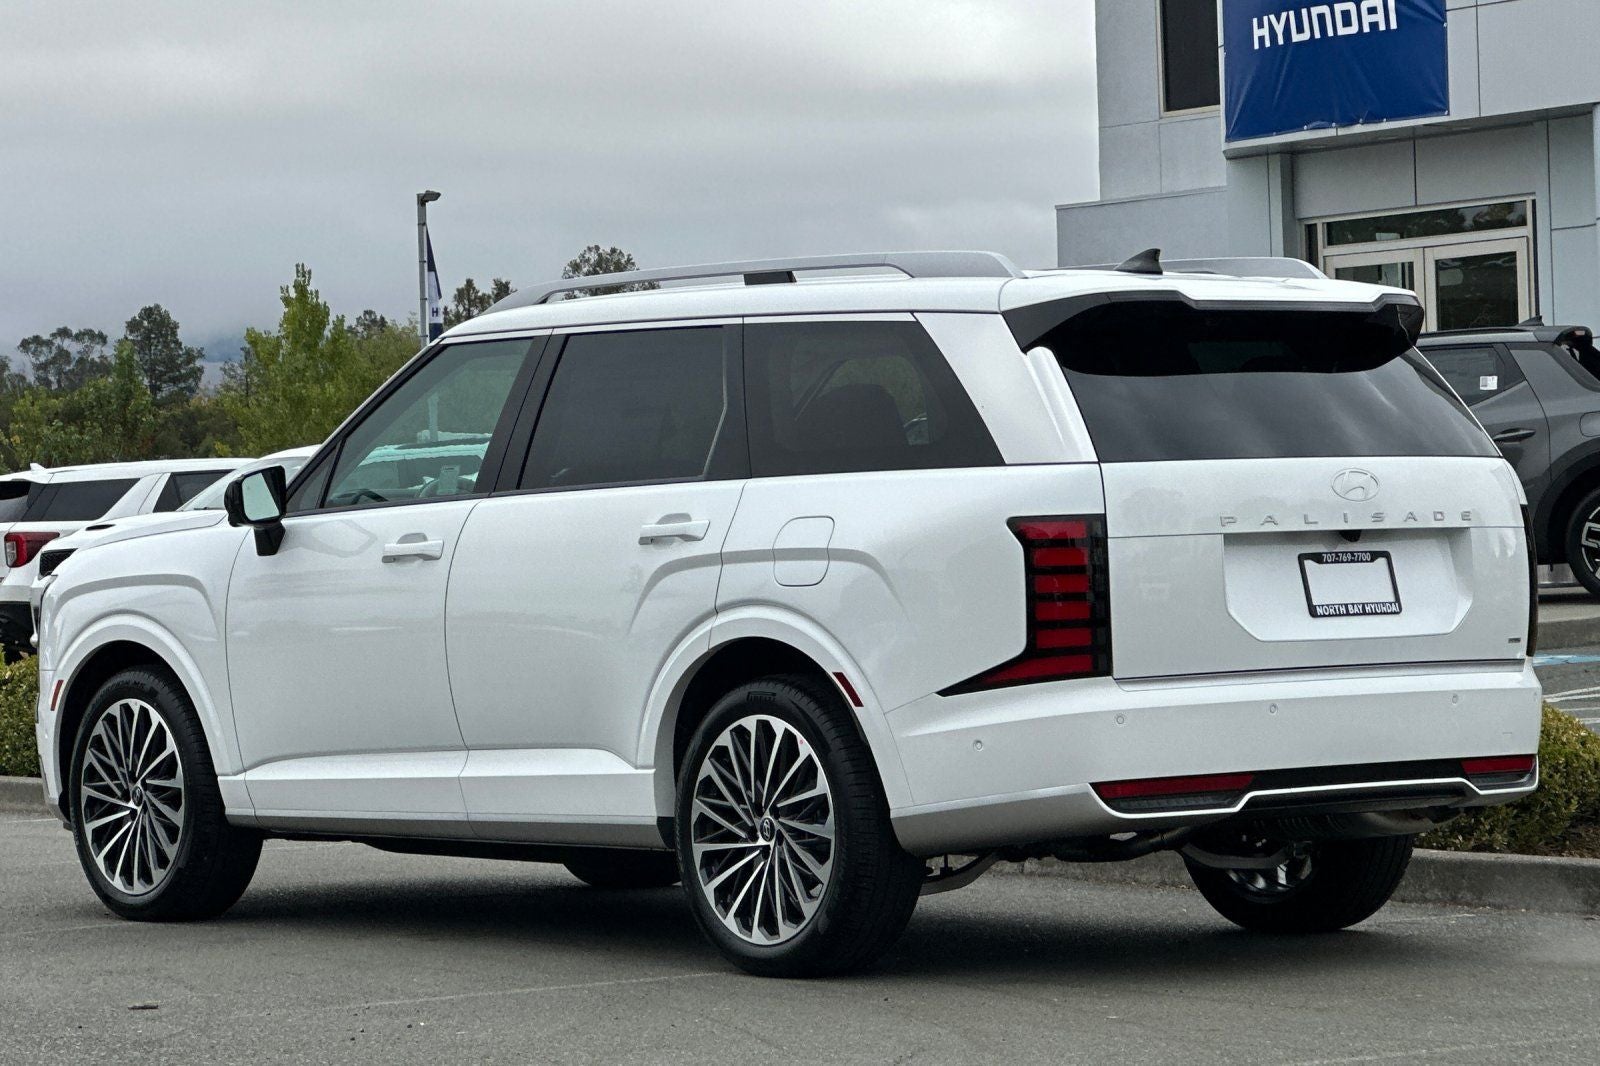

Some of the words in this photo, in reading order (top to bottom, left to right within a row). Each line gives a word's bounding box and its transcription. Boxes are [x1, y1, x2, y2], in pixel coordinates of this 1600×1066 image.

[1252, 0, 1398, 50] HYUNDAI
[1219, 510, 1473, 527] PALISADE
[1322, 552, 1371, 562] 707-769-7700
[1315, 604, 1346, 616] NORTH
[1347, 603, 1363, 614] BAY
[1365, 602, 1400, 613] HYUNDAI
